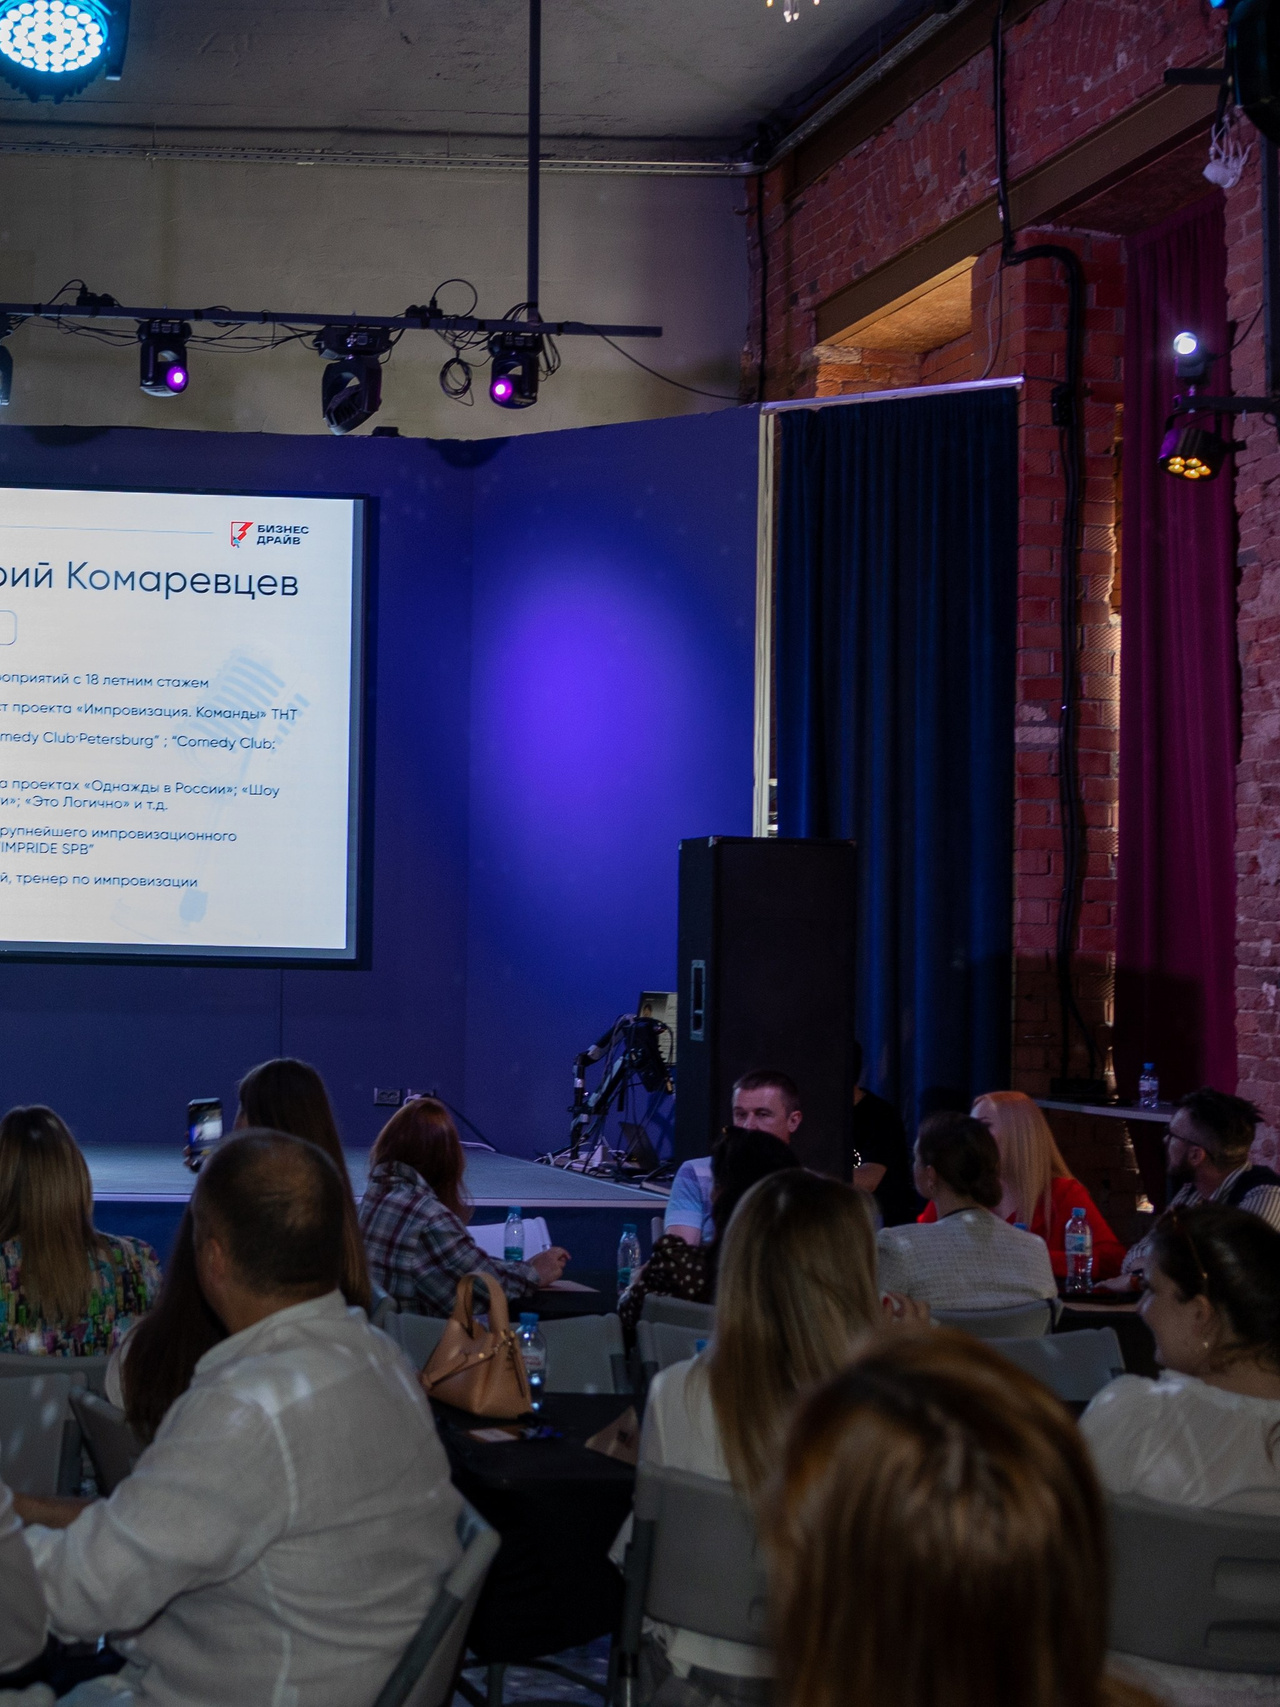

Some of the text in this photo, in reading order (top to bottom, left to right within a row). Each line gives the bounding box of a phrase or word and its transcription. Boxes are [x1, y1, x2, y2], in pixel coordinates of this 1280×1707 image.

[257, 524, 310, 536] БИЗНЕС
[256, 534, 301, 546] ДРАЙВ
[67, 561, 299, 601] Комаревцев
[72, 676, 82, 685] с
[85, 673, 100, 685] 18
[102, 676, 153, 687] летним
[156, 678, 209, 689] стажем
[12, 702, 72, 716] проекта
[76, 702, 192, 719] «Импровизация.
[195, 706, 267, 721] Команды»
[271, 708, 298, 721] ТНТ
[12, 779, 80, 791] проектах
[84, 779, 160, 794] «Однажды
[163, 784, 171, 793] в
[175, 782, 238, 797] России»;
[241, 784, 280, 799] «Шоу
[25, 794, 59, 808] «Это
[62, 796, 130, 810] Логично»
[134, 800, 143, 810] и
[146, 800, 168, 812] т.д.
[91, 828, 238, 843] импровизационного
[16, 873, 68, 886] тренер
[72, 874, 90, 886] по
[93, 875, 199, 889] импровизации
